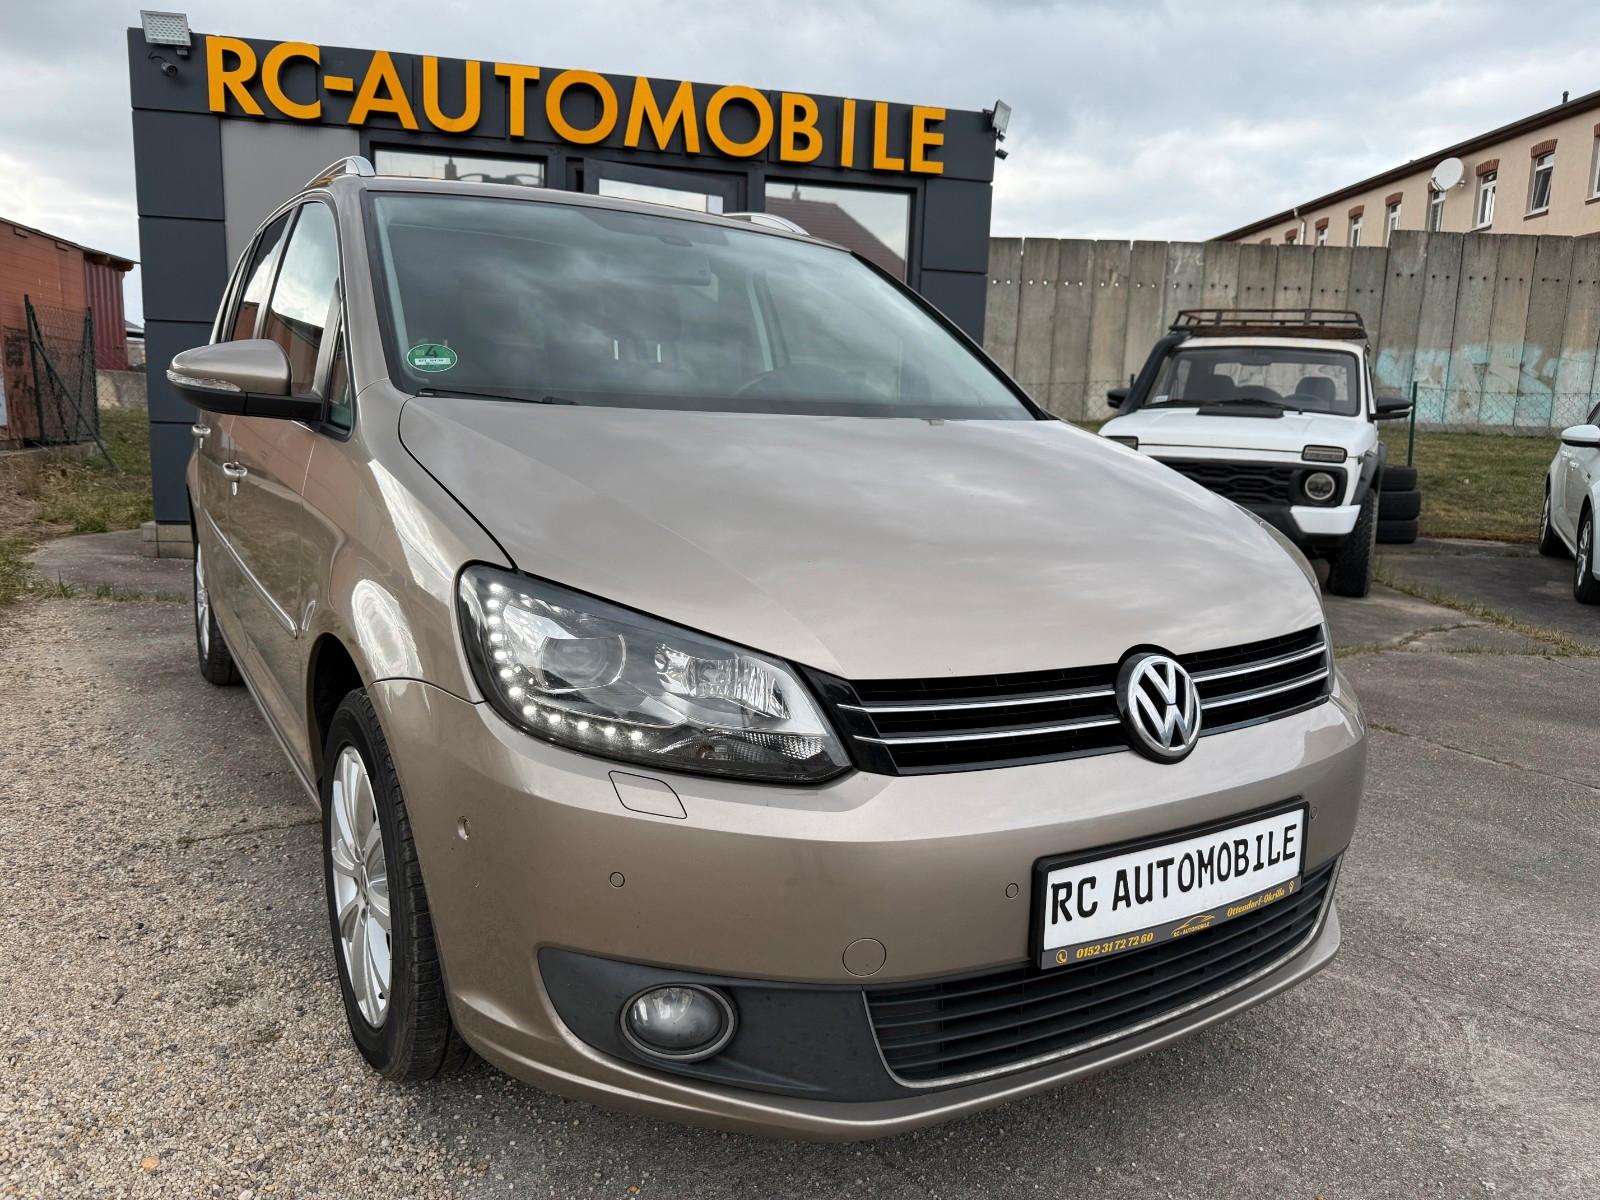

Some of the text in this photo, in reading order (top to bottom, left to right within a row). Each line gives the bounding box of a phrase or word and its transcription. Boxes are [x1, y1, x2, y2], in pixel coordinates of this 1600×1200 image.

[206, 36, 946, 175] RC-AUTOMOBILE
[425, 345, 439, 358] 4
[1050, 823, 1298, 925] RC AUTOMOBILE
[1076, 945, 1101, 959] 0152
[1141, 932, 1154, 944] 60
